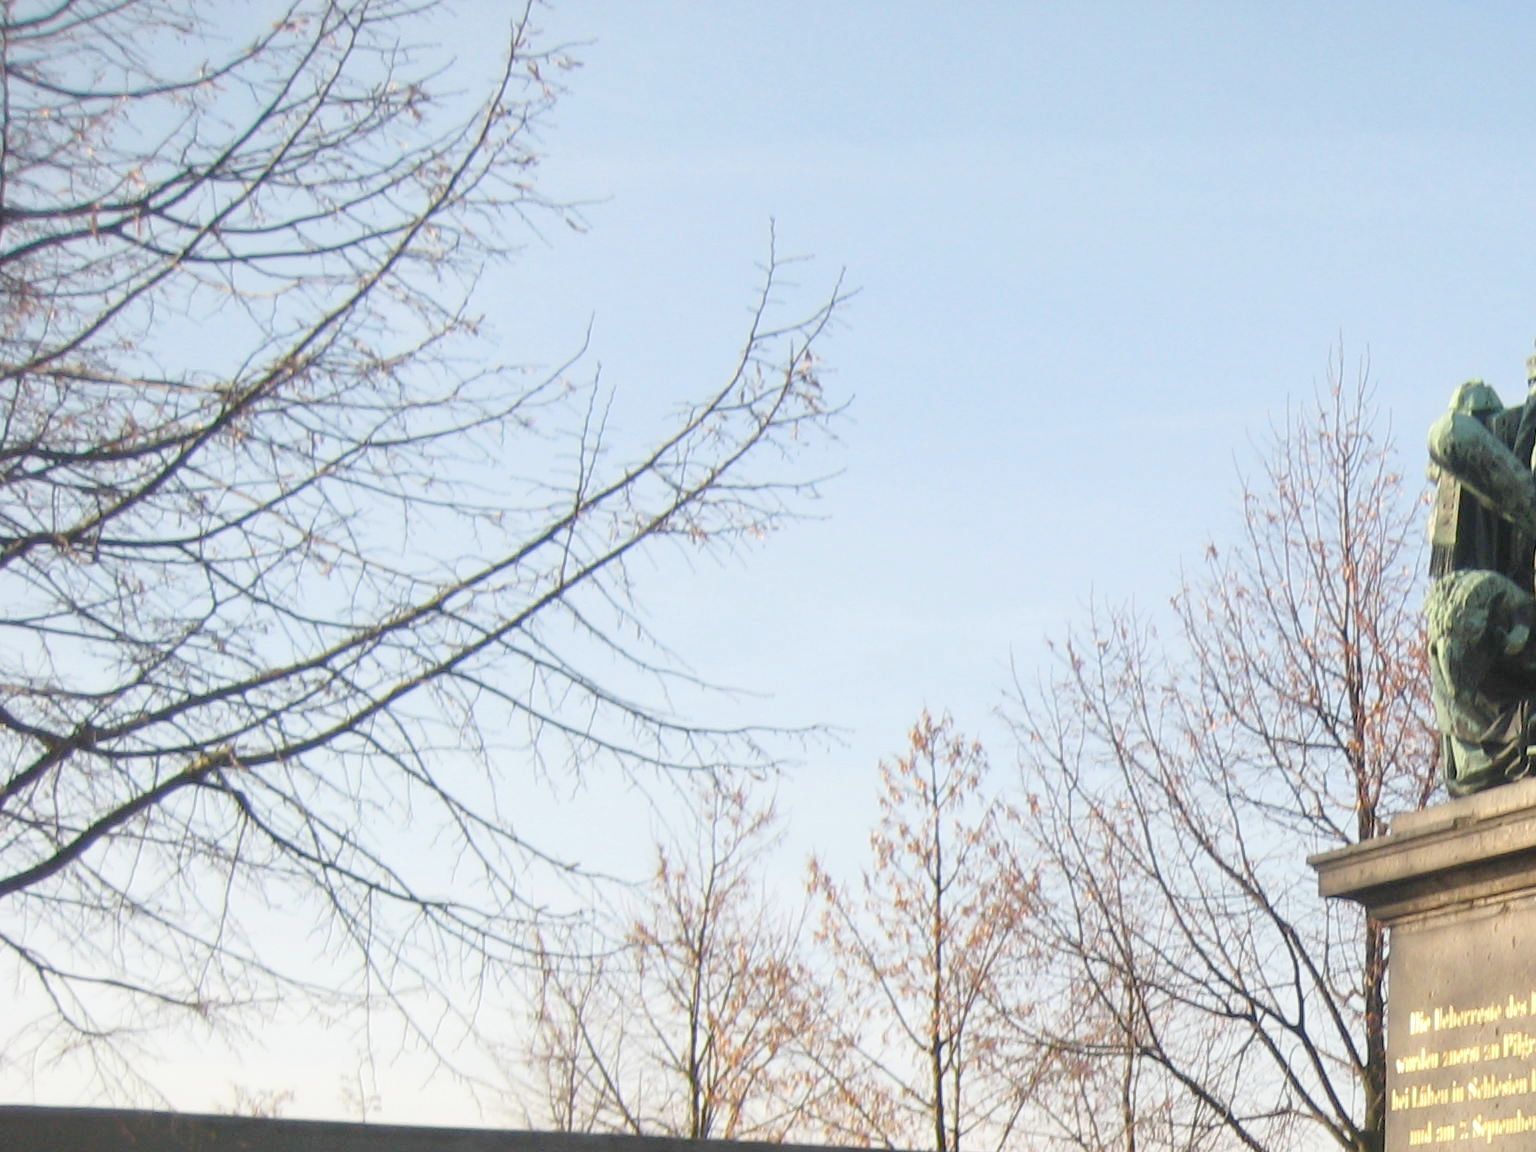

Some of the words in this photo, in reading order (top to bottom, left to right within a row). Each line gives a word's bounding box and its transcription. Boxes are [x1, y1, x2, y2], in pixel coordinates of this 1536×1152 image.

[1410, 1010, 1431, 1035] Die
[1505, 994, 1527, 1019] des
[1396, 1048, 1438, 1074] wurden
[1391, 1089, 1408, 1111] bei
[1452, 1080, 1464, 1103] in
[1468, 1073, 1527, 1102] Schlesien
[1409, 1122, 1432, 1145] und
[1436, 1123, 1455, 1141] am
